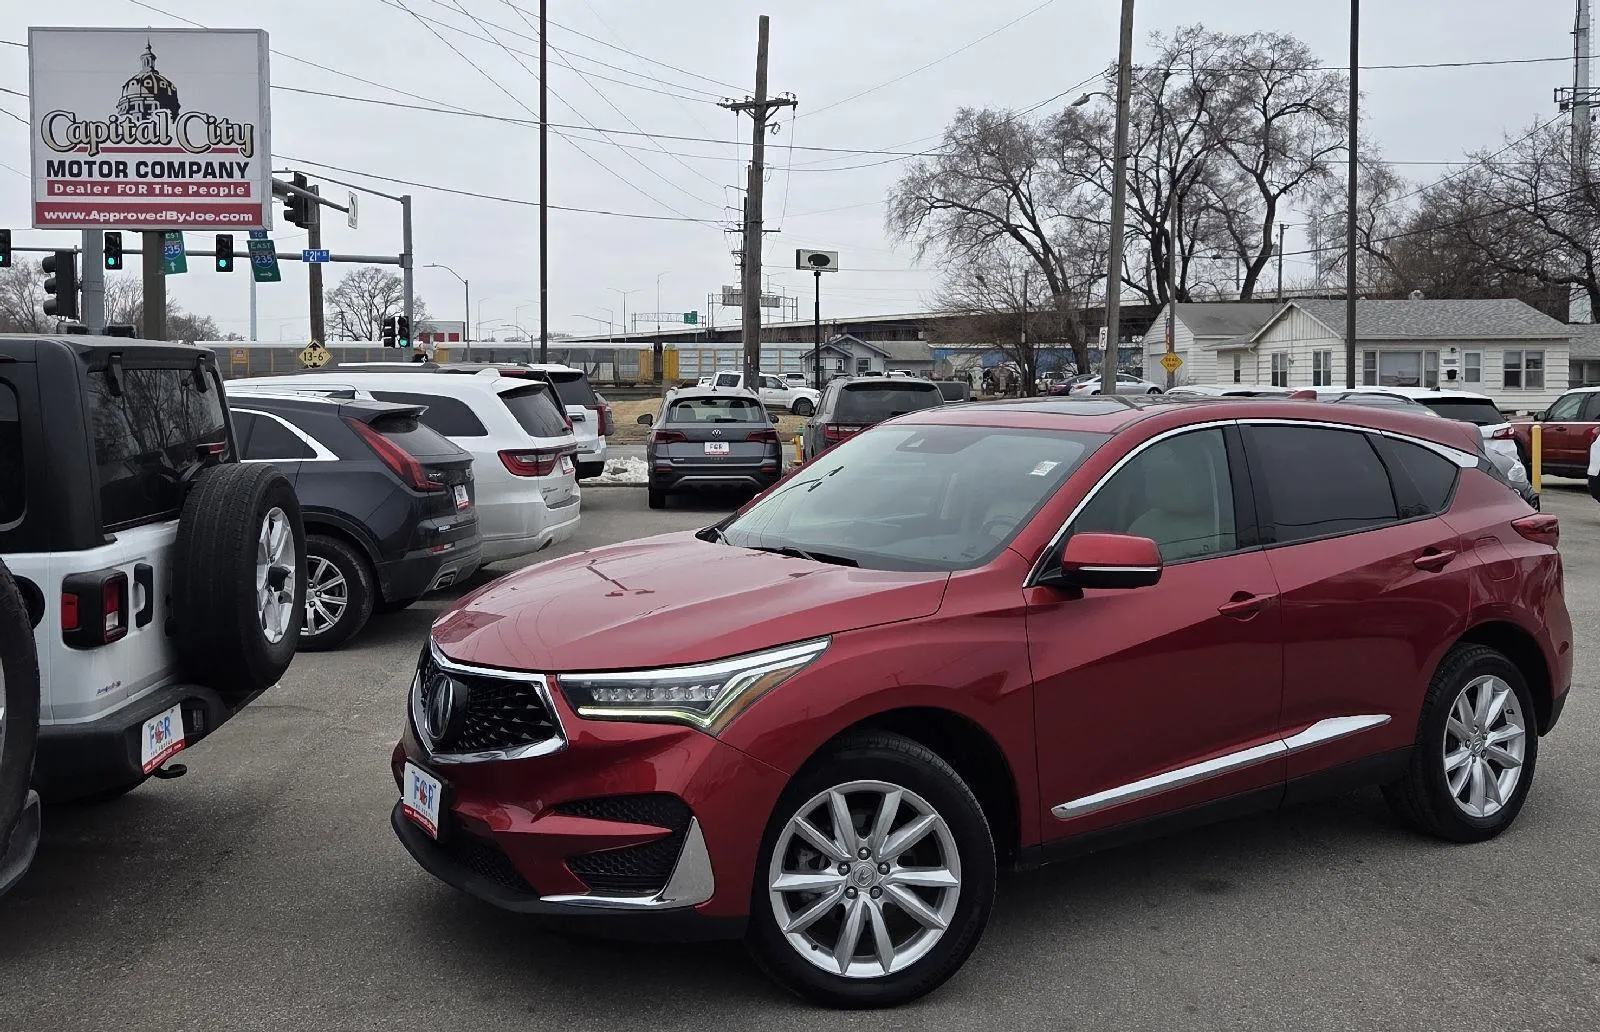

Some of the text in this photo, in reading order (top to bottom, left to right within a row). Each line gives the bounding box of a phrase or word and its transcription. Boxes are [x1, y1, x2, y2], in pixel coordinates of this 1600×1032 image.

[41, 110, 254, 158] Capital City
[46, 160, 250, 179] MOTOR COMPANY
[54, 183, 245, 197] Dealer FOR The People
[44, 210, 253, 222] www.ApprovedByJoe.com
[250, 241, 271, 249] EAST
[255, 256, 273, 264] 235
